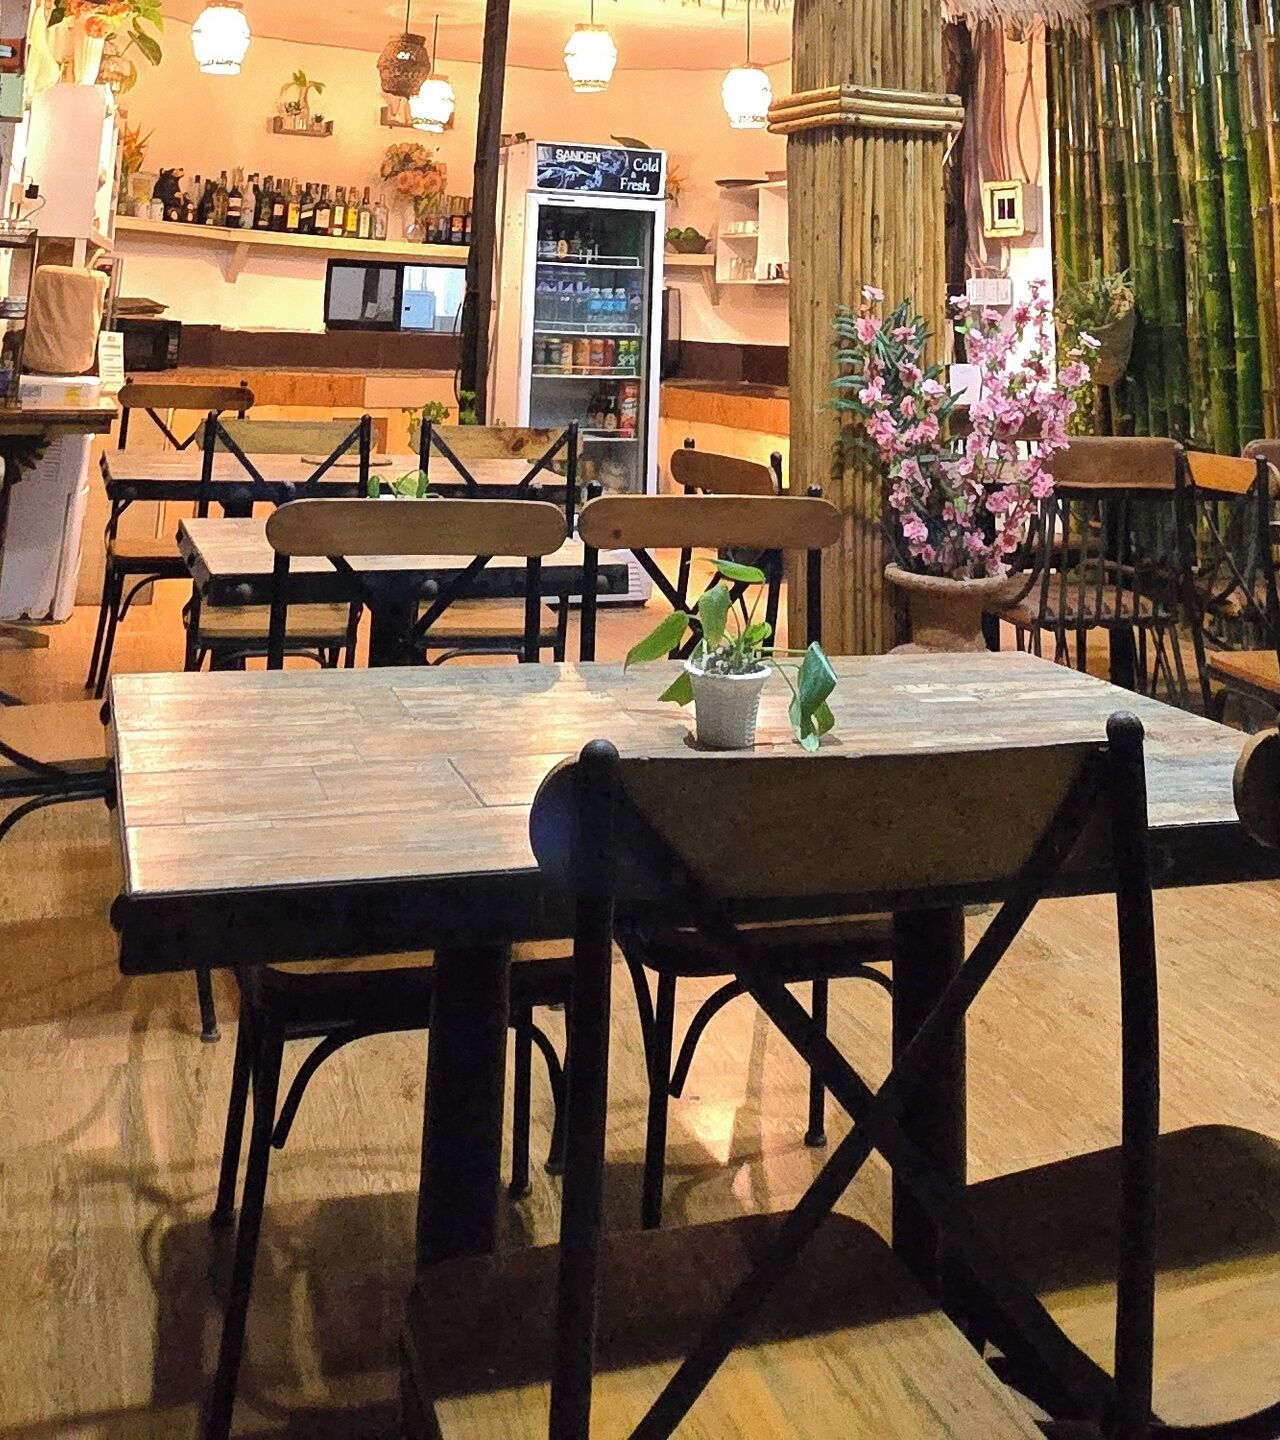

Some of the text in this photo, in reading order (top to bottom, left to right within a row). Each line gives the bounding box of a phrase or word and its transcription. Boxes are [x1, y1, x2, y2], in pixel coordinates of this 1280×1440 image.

[555, 149, 601, 163] SANDEN
[633, 157, 660, 173] Cold
[620, 177, 651, 192] Fresh
